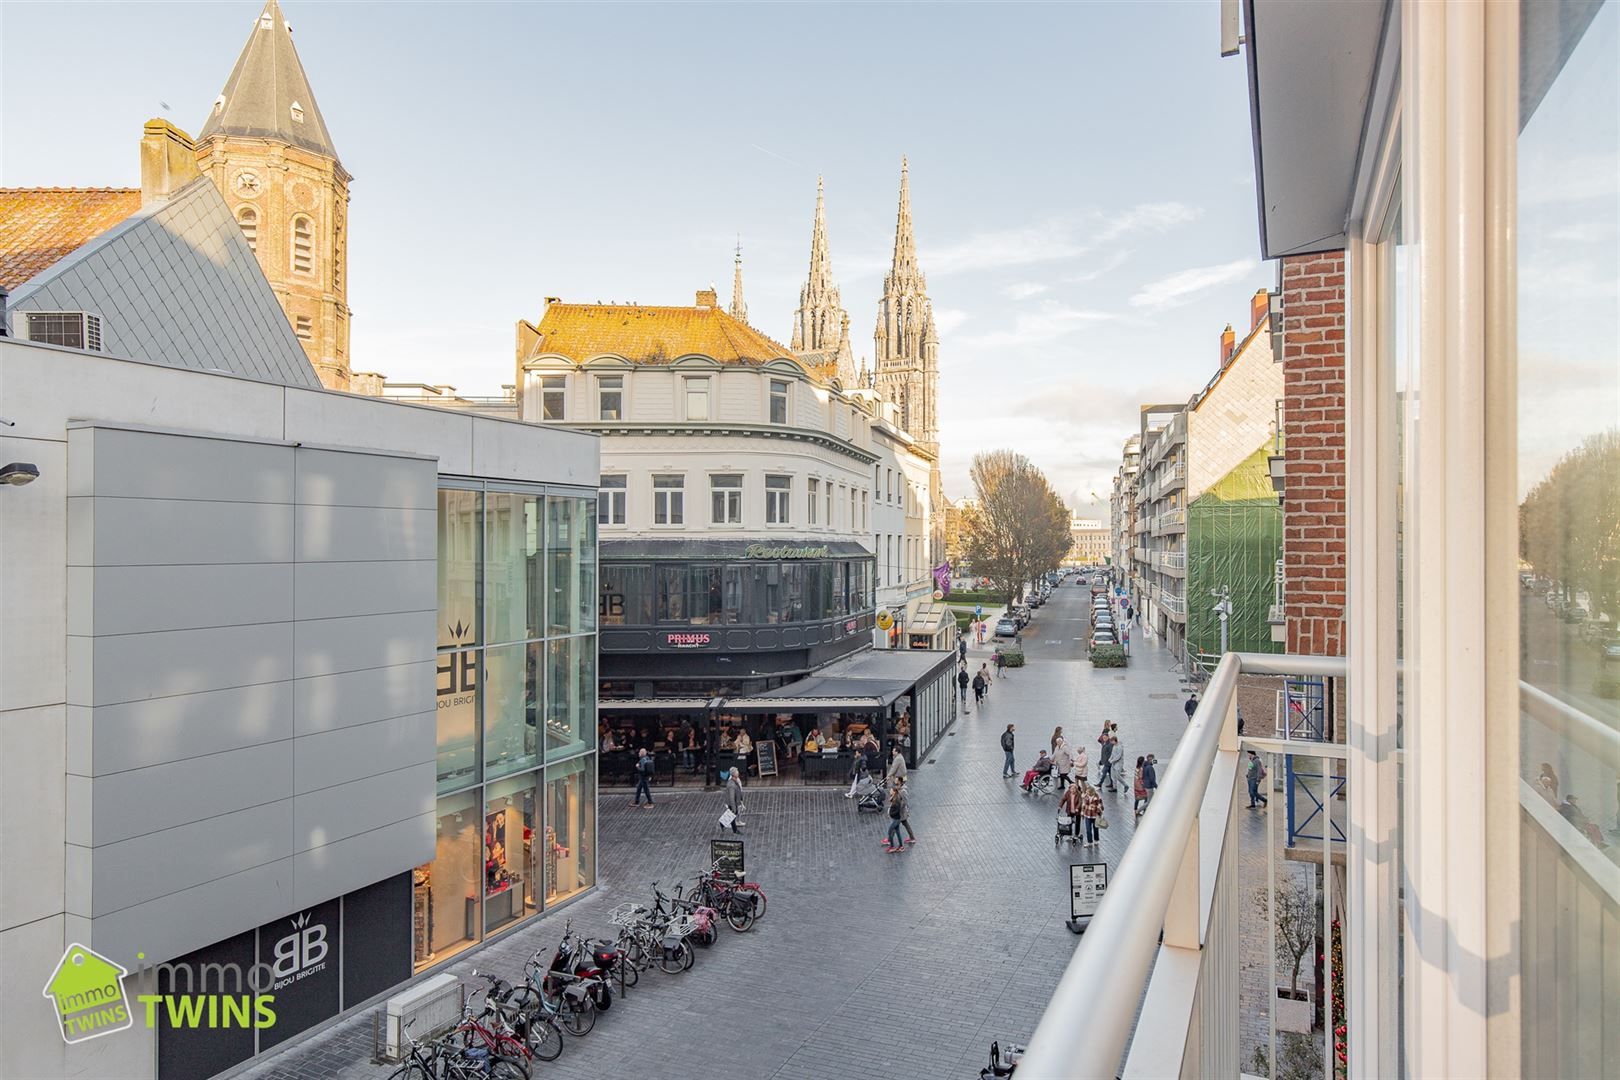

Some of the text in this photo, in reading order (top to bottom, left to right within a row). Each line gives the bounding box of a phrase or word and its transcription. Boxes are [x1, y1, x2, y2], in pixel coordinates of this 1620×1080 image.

[745, 543, 828, 559] Restaurant
[667, 633, 710, 644] PRIMUS
[453, 695, 475, 707] BRIGI
[274, 962, 326, 991] BIJOU BRIGITTE
